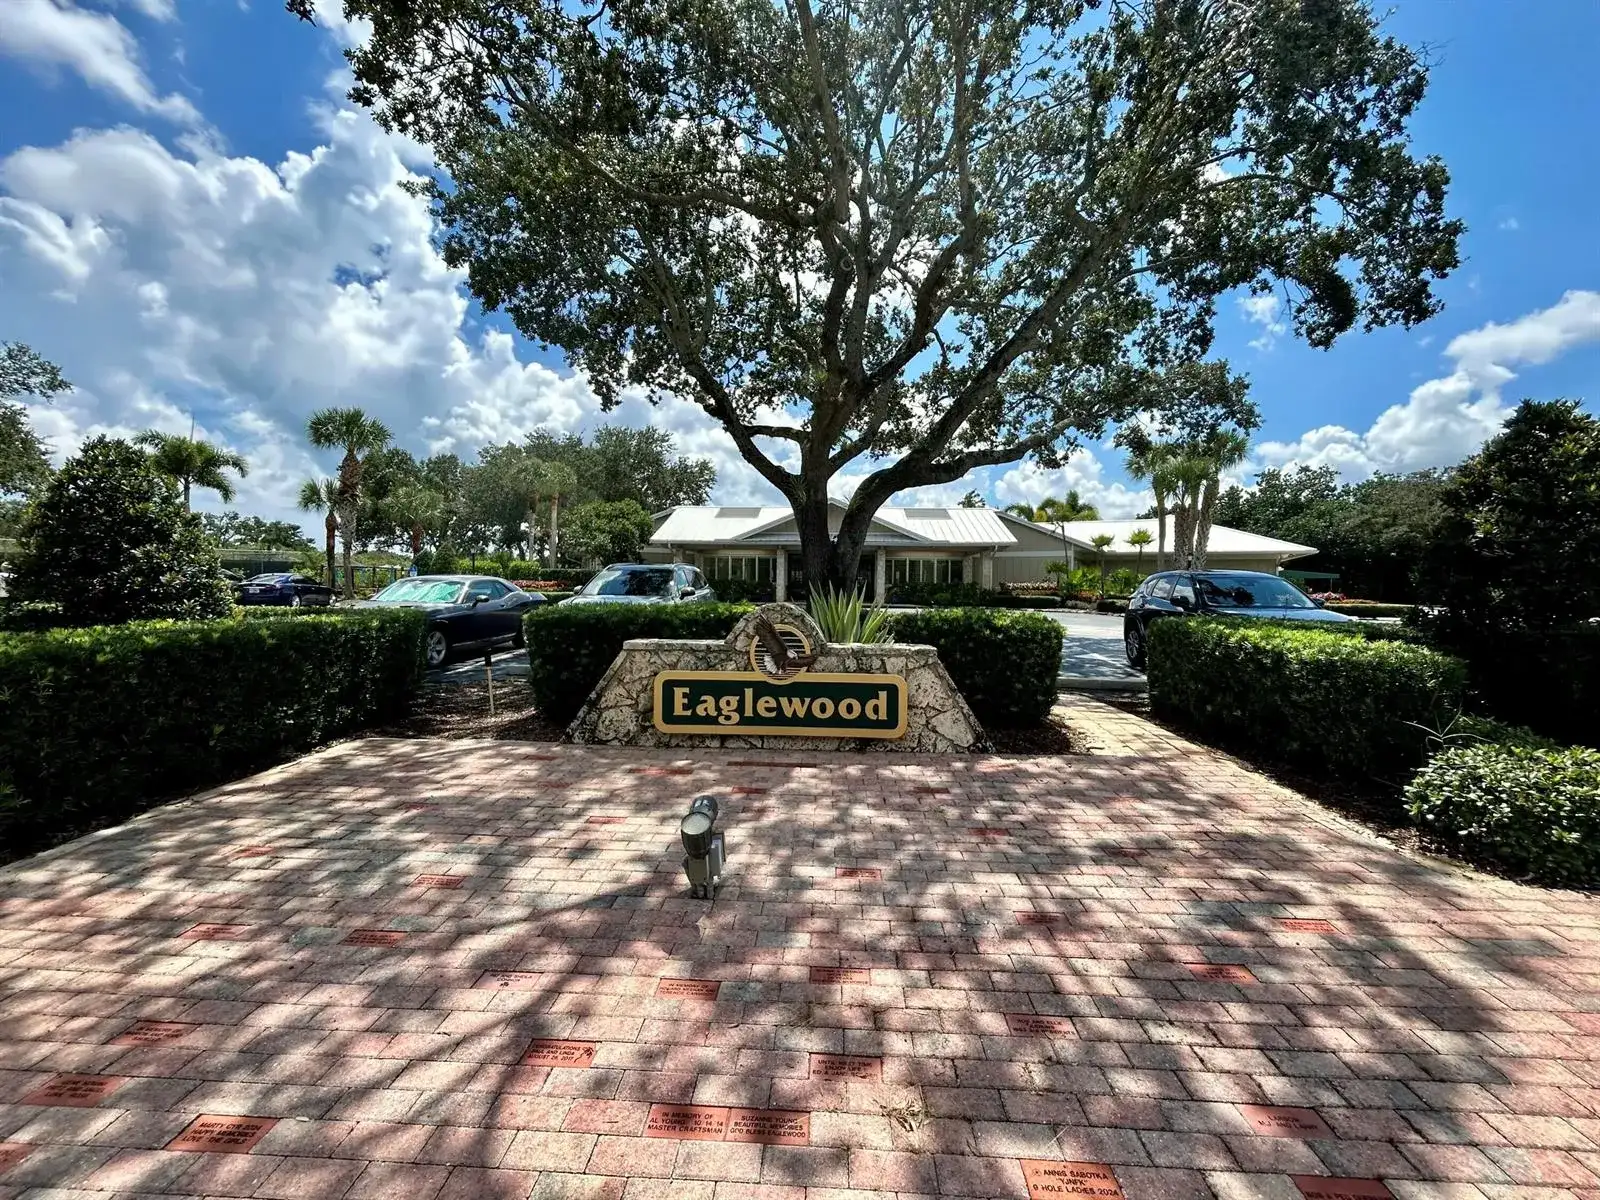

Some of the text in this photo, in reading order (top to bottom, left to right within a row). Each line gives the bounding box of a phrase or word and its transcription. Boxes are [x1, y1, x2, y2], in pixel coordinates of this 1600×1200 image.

[673, 687, 888, 725] Eaglewood
[672, 1112, 701, 1120] MEMORY
[741, 1115, 798, 1125] SUZANNE YOUNG
[198, 1121, 225, 1129] MARTY
[661, 1118, 686, 1126] YOUNG
[733, 1121, 804, 1131] BEAUTIFUL MEMORIES
[190, 1128, 257, 1138] HAPPY MEMORIES
[647, 1123, 723, 1135] MASTER CRAFTSMAN
[730, 1127, 806, 1138] GOD BLESS EAGLEWOOD
[181, 1135, 204, 1143] LOVE
[1043, 1169, 1109, 1180] ANNIS SABOTKA
[1042, 1184, 1064, 1193] HOLE
[1065, 1186, 1096, 1195] LADIES
